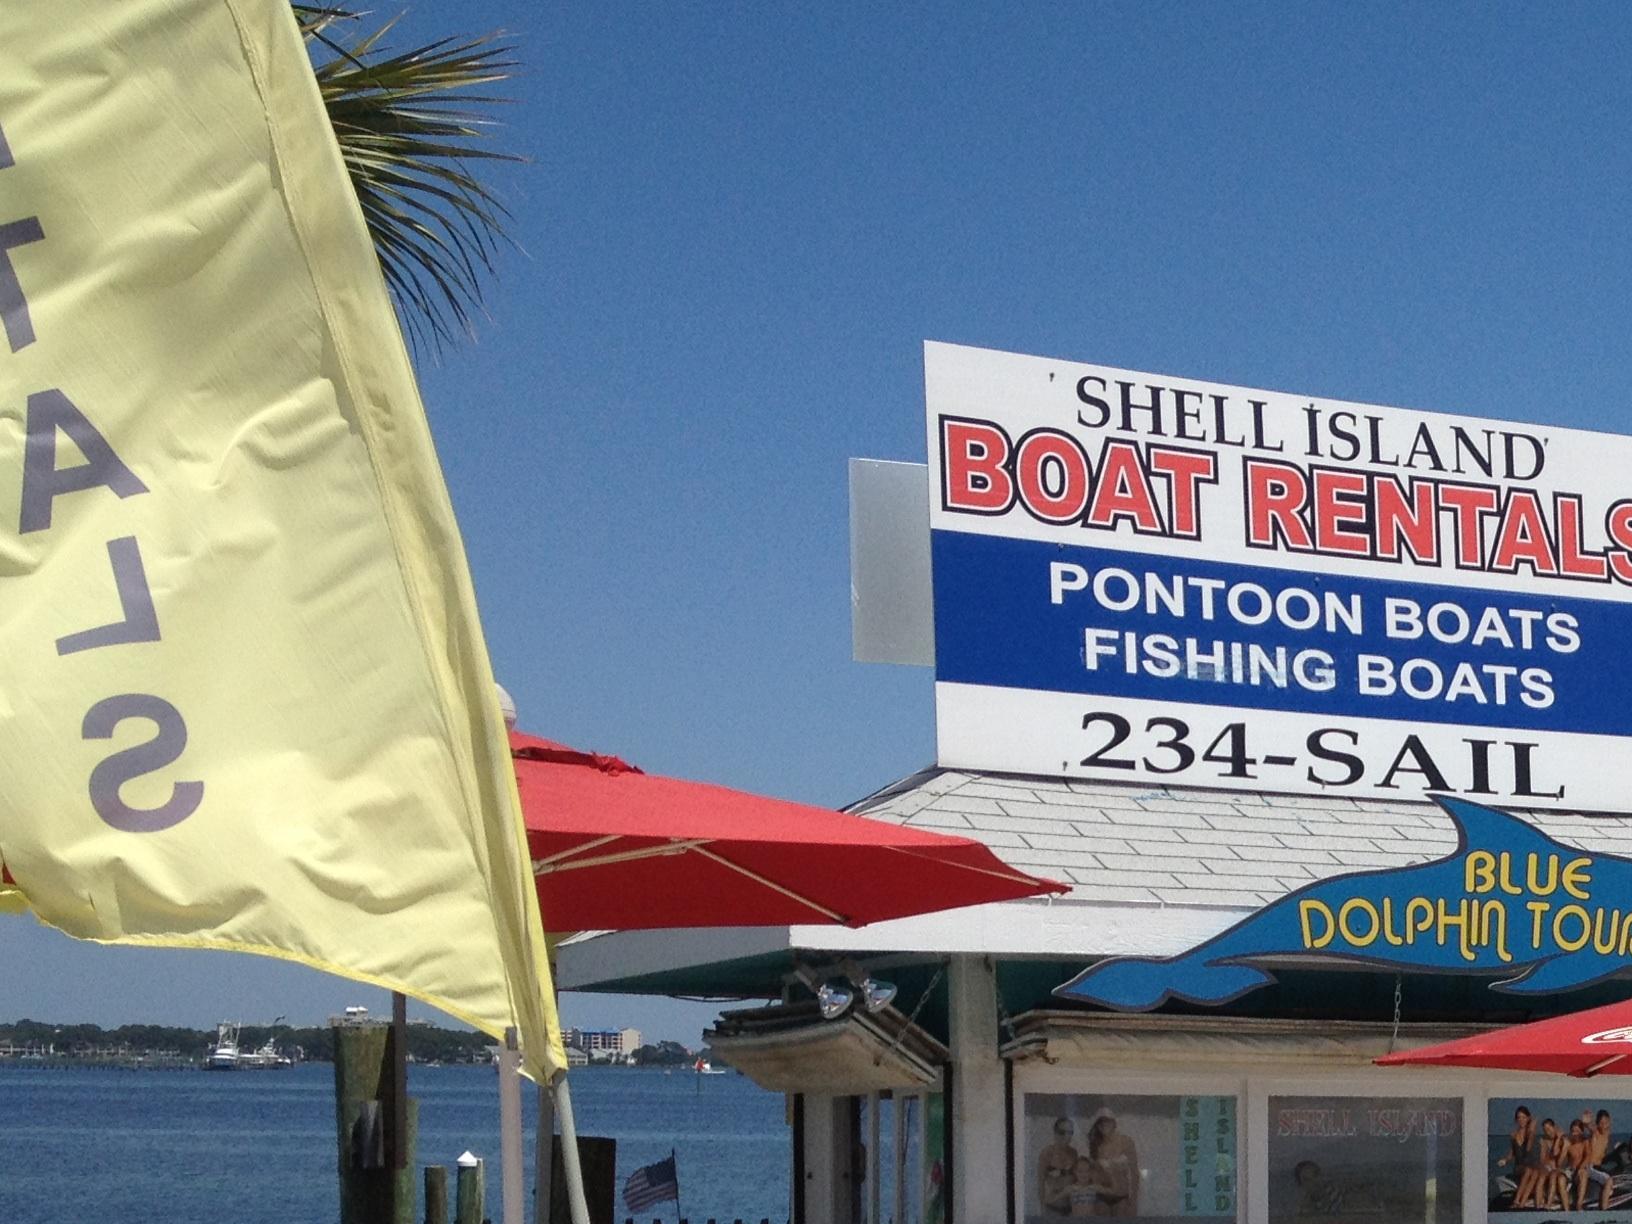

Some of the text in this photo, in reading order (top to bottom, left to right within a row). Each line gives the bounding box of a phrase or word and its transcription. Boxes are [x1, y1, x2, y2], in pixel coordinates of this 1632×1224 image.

[1076, 376, 1546, 481] SHELL ISLAND
[938, 414, 1217, 541] BOAT
[1049, 561, 1581, 655] PONTOON BOATS
[1085, 627, 1555, 709] FISHING BOATS
[1080, 710, 1566, 800] 234-SAIL
[1464, 850, 1593, 900] BLUE
[1299, 896, 1513, 963] DOLPHIN
[1183, 1098, 1200, 1212] SHELL
[1278, 1109, 1456, 1143] SHELL ISLAND
